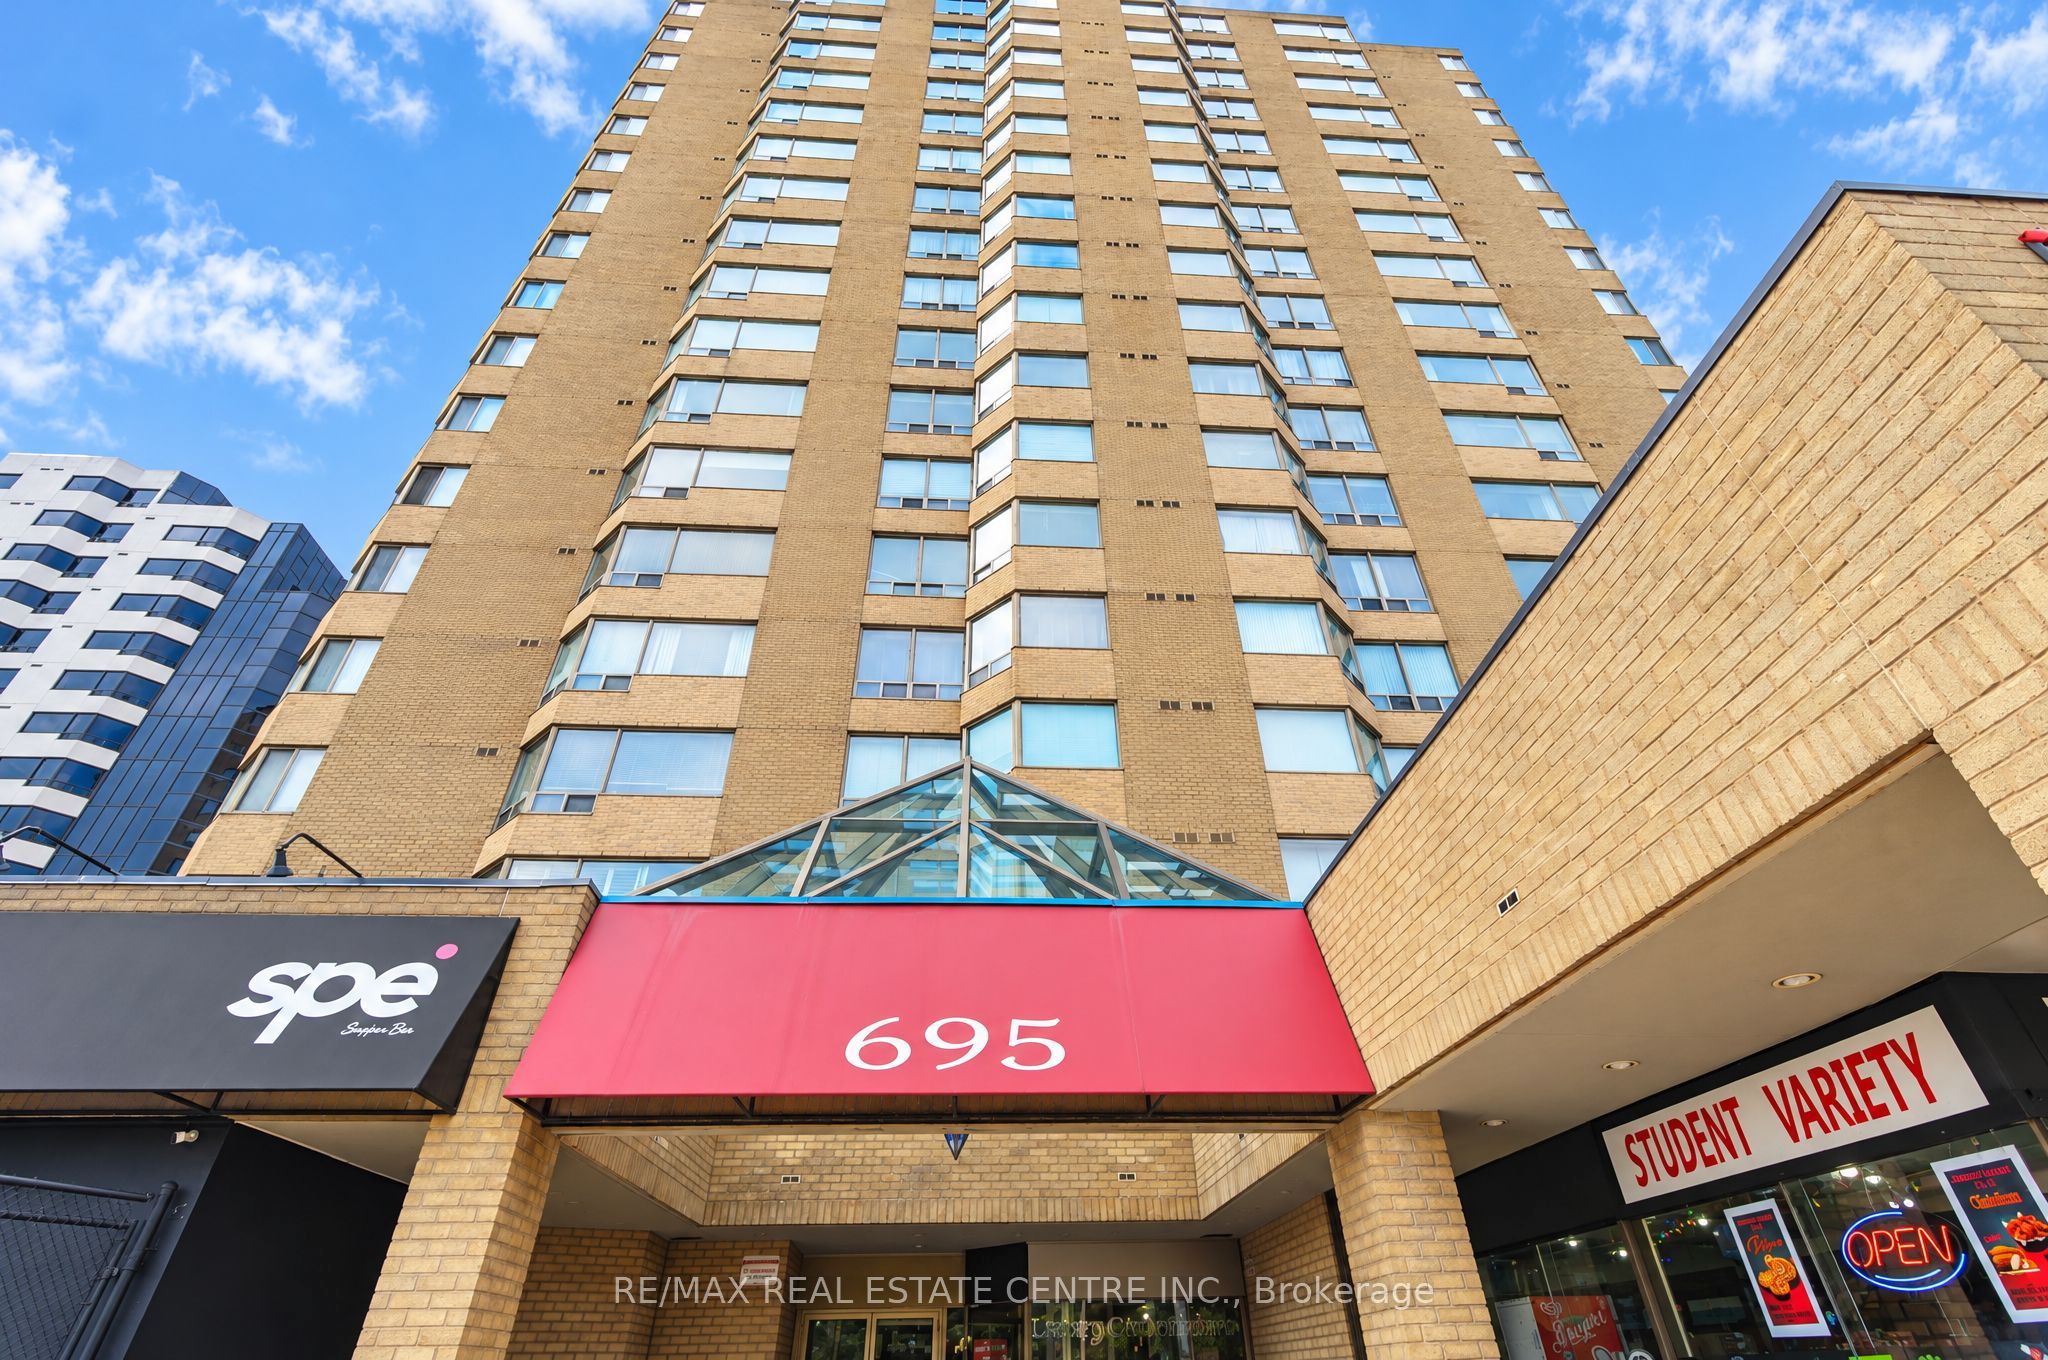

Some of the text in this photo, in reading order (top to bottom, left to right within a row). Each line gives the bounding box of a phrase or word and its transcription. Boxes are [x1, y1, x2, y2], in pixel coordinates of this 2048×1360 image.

[340, 1021, 388, 1037] Supper
[844, 1016, 1066, 1071] 695
[1624, 1031, 1937, 1187] STUDENT VARIETY
[1847, 1224, 1954, 1268] OPEN
